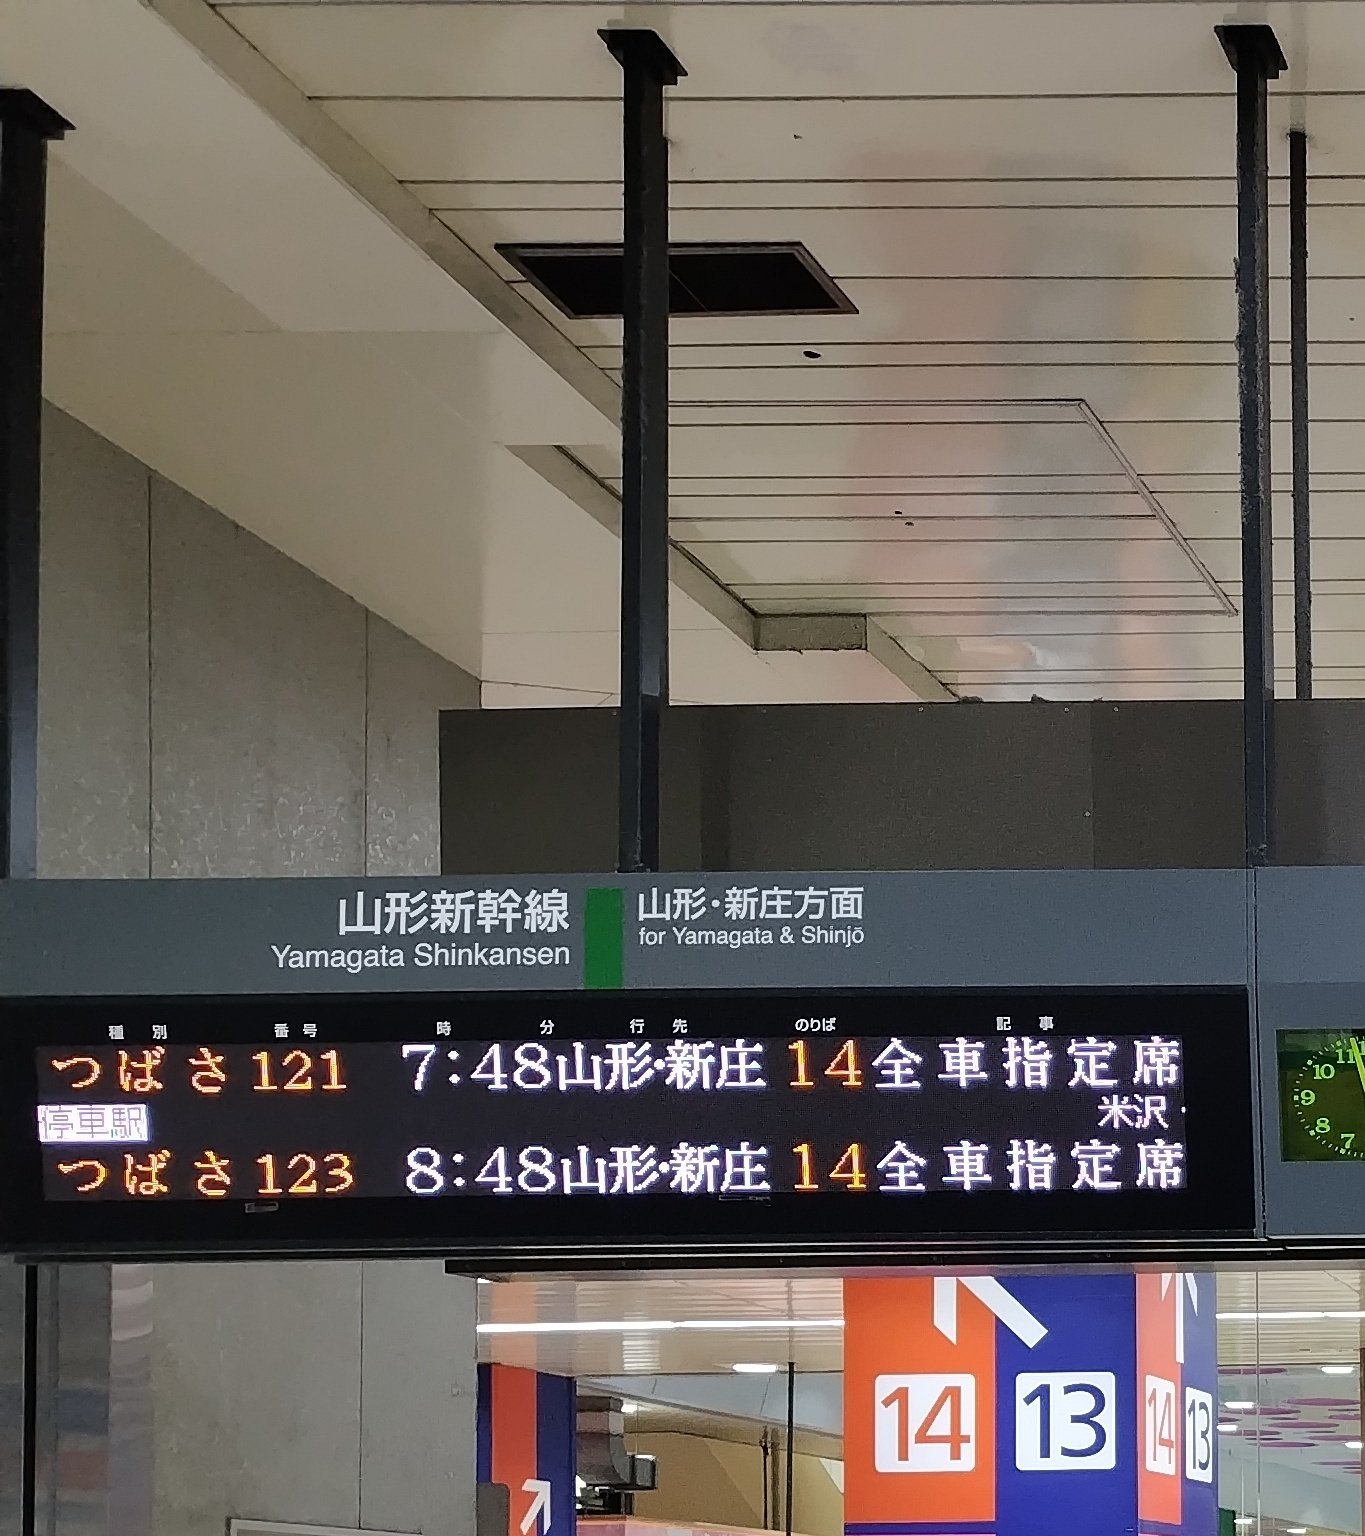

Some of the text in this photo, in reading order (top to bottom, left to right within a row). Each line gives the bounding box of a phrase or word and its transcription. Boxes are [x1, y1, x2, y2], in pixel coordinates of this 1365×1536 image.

[338, 888, 570, 935] 山形新幹線
[639, 886, 863, 921] 山形・新庄方面
[272, 941, 570, 974] Yamagata Shinkansen
[639, 924, 864, 948] for Yamagata & Shinjō
[795, 1017, 836, 1032] のりば
[788, 1039, 862, 1089] 14
[1313, 1064, 1335, 1079] 10
[793, 1143, 867, 1190] 14
[882, 1384, 972, 1464] 14
[1022, 1382, 1107, 1461] 13
[1148, 1388, 1174, 1464] 14
[1188, 1399, 1211, 1471] 13
